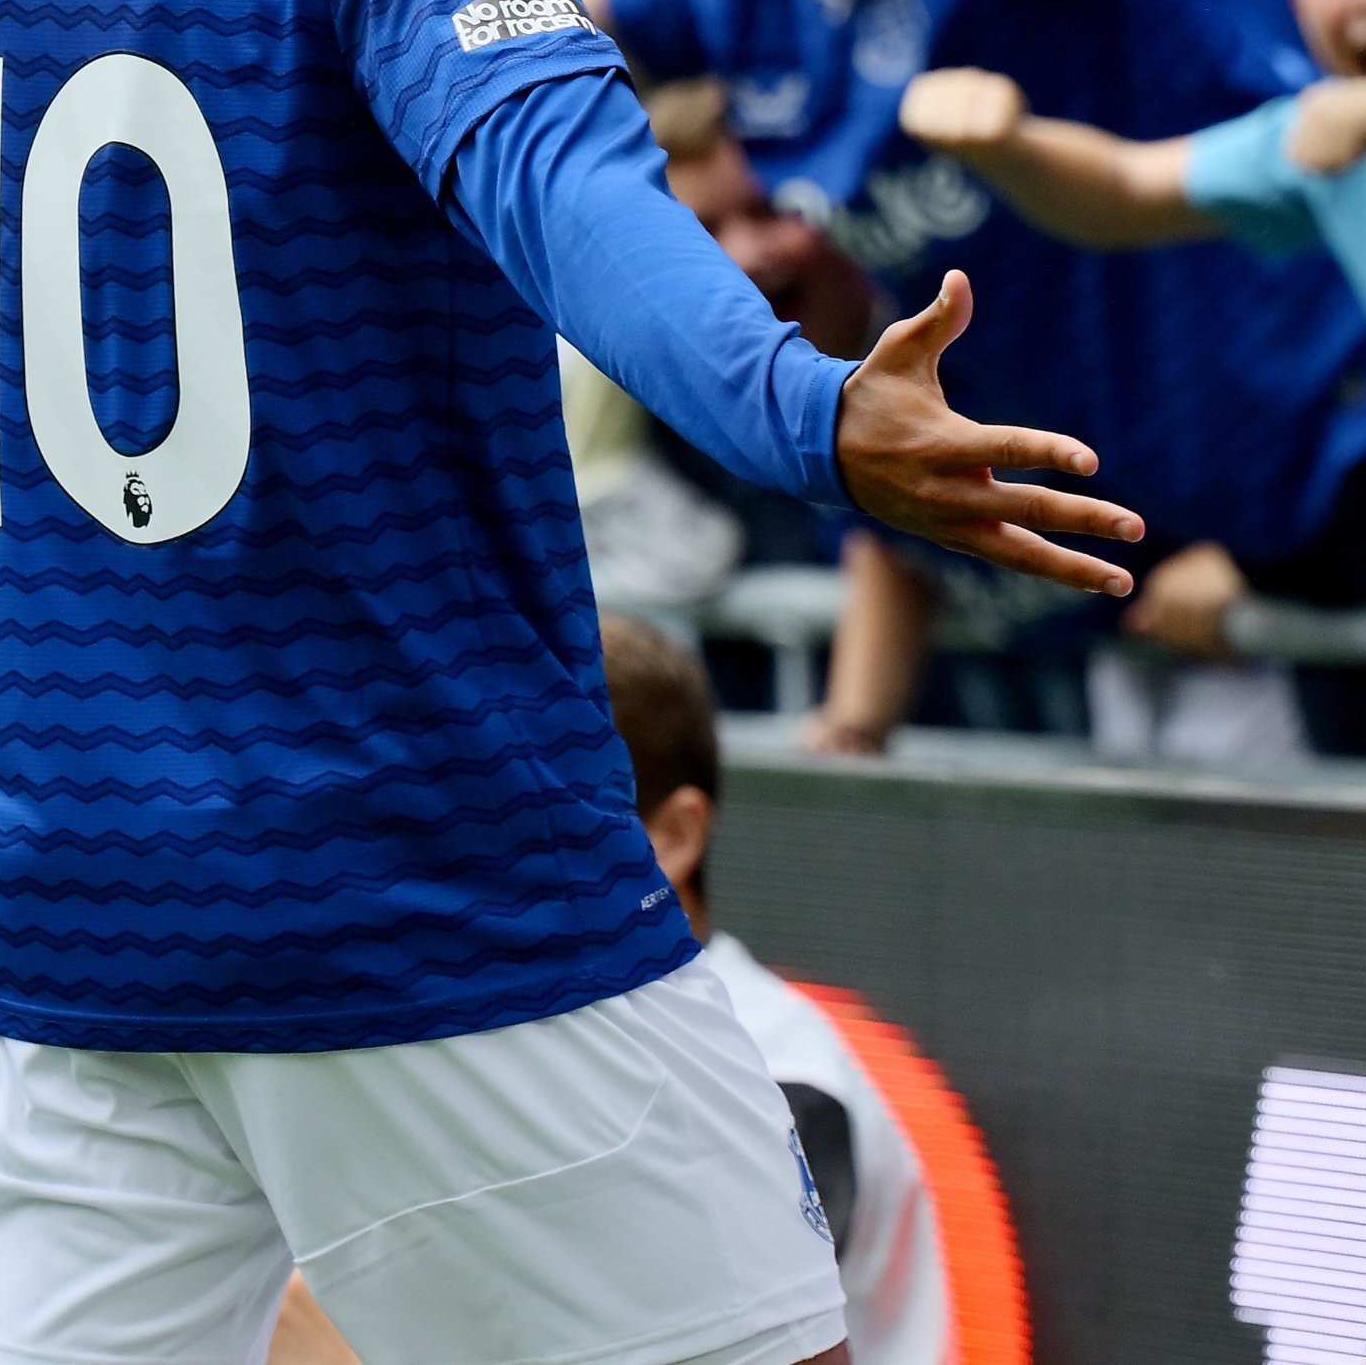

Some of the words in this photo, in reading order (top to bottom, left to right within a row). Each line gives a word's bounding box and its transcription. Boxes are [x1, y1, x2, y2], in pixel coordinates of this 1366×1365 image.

[452, 2, 498, 32] No
[457, 18, 504, 52] for
[505, 13, 598, 36] racism
